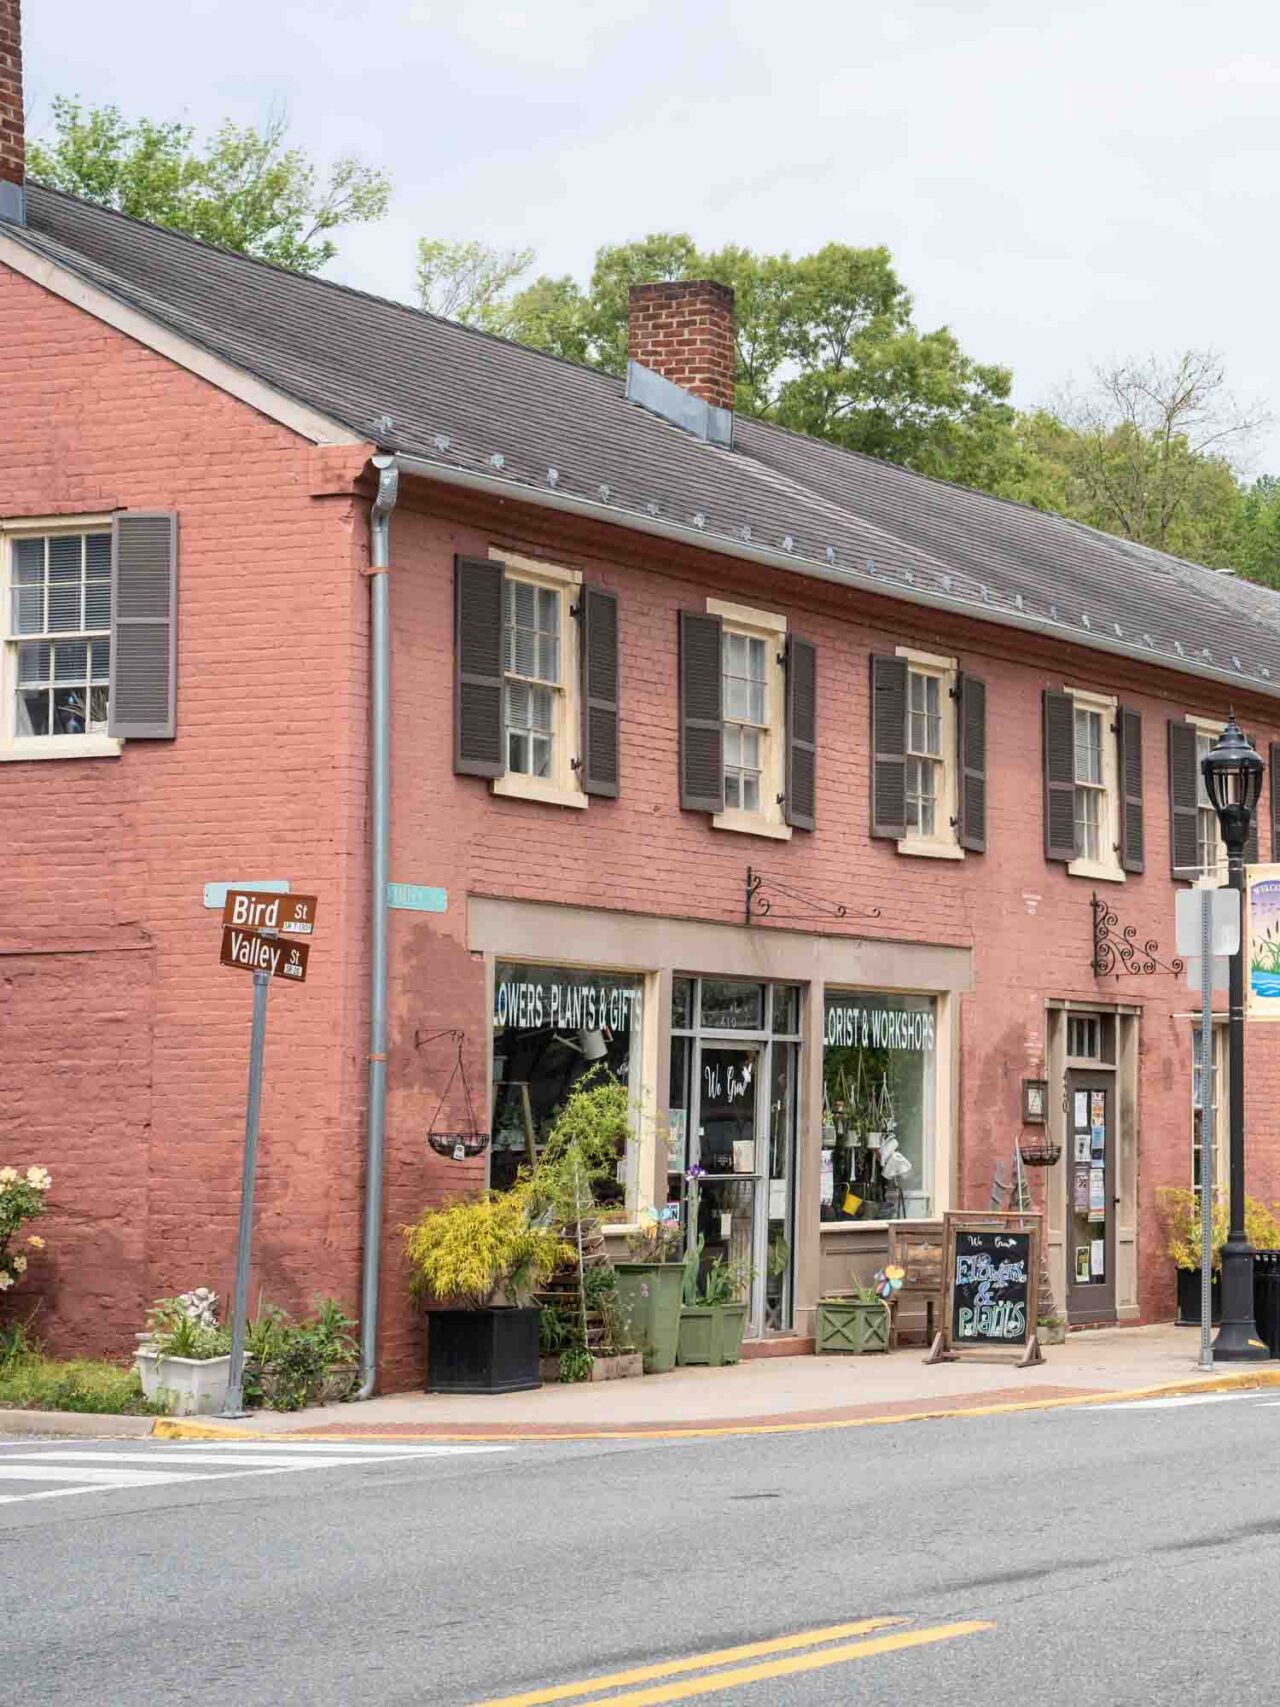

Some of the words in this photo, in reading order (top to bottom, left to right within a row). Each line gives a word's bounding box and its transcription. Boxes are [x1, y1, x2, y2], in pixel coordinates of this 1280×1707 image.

[232, 895, 279, 926] Bird
[294, 903, 308, 919] St
[231, 932, 281, 976] Valley
[289, 949, 300, 965] St
[550, 985, 596, 1030] PLANTS
[599, 988, 607, 1030] &
[610, 988, 642, 1031] GIFTS
[861, 1009, 869, 1048] &
[872, 1010, 934, 1050] WORKSHOPS
[704, 1063, 721, 1098] We
[974, 1281, 996, 1306] &
